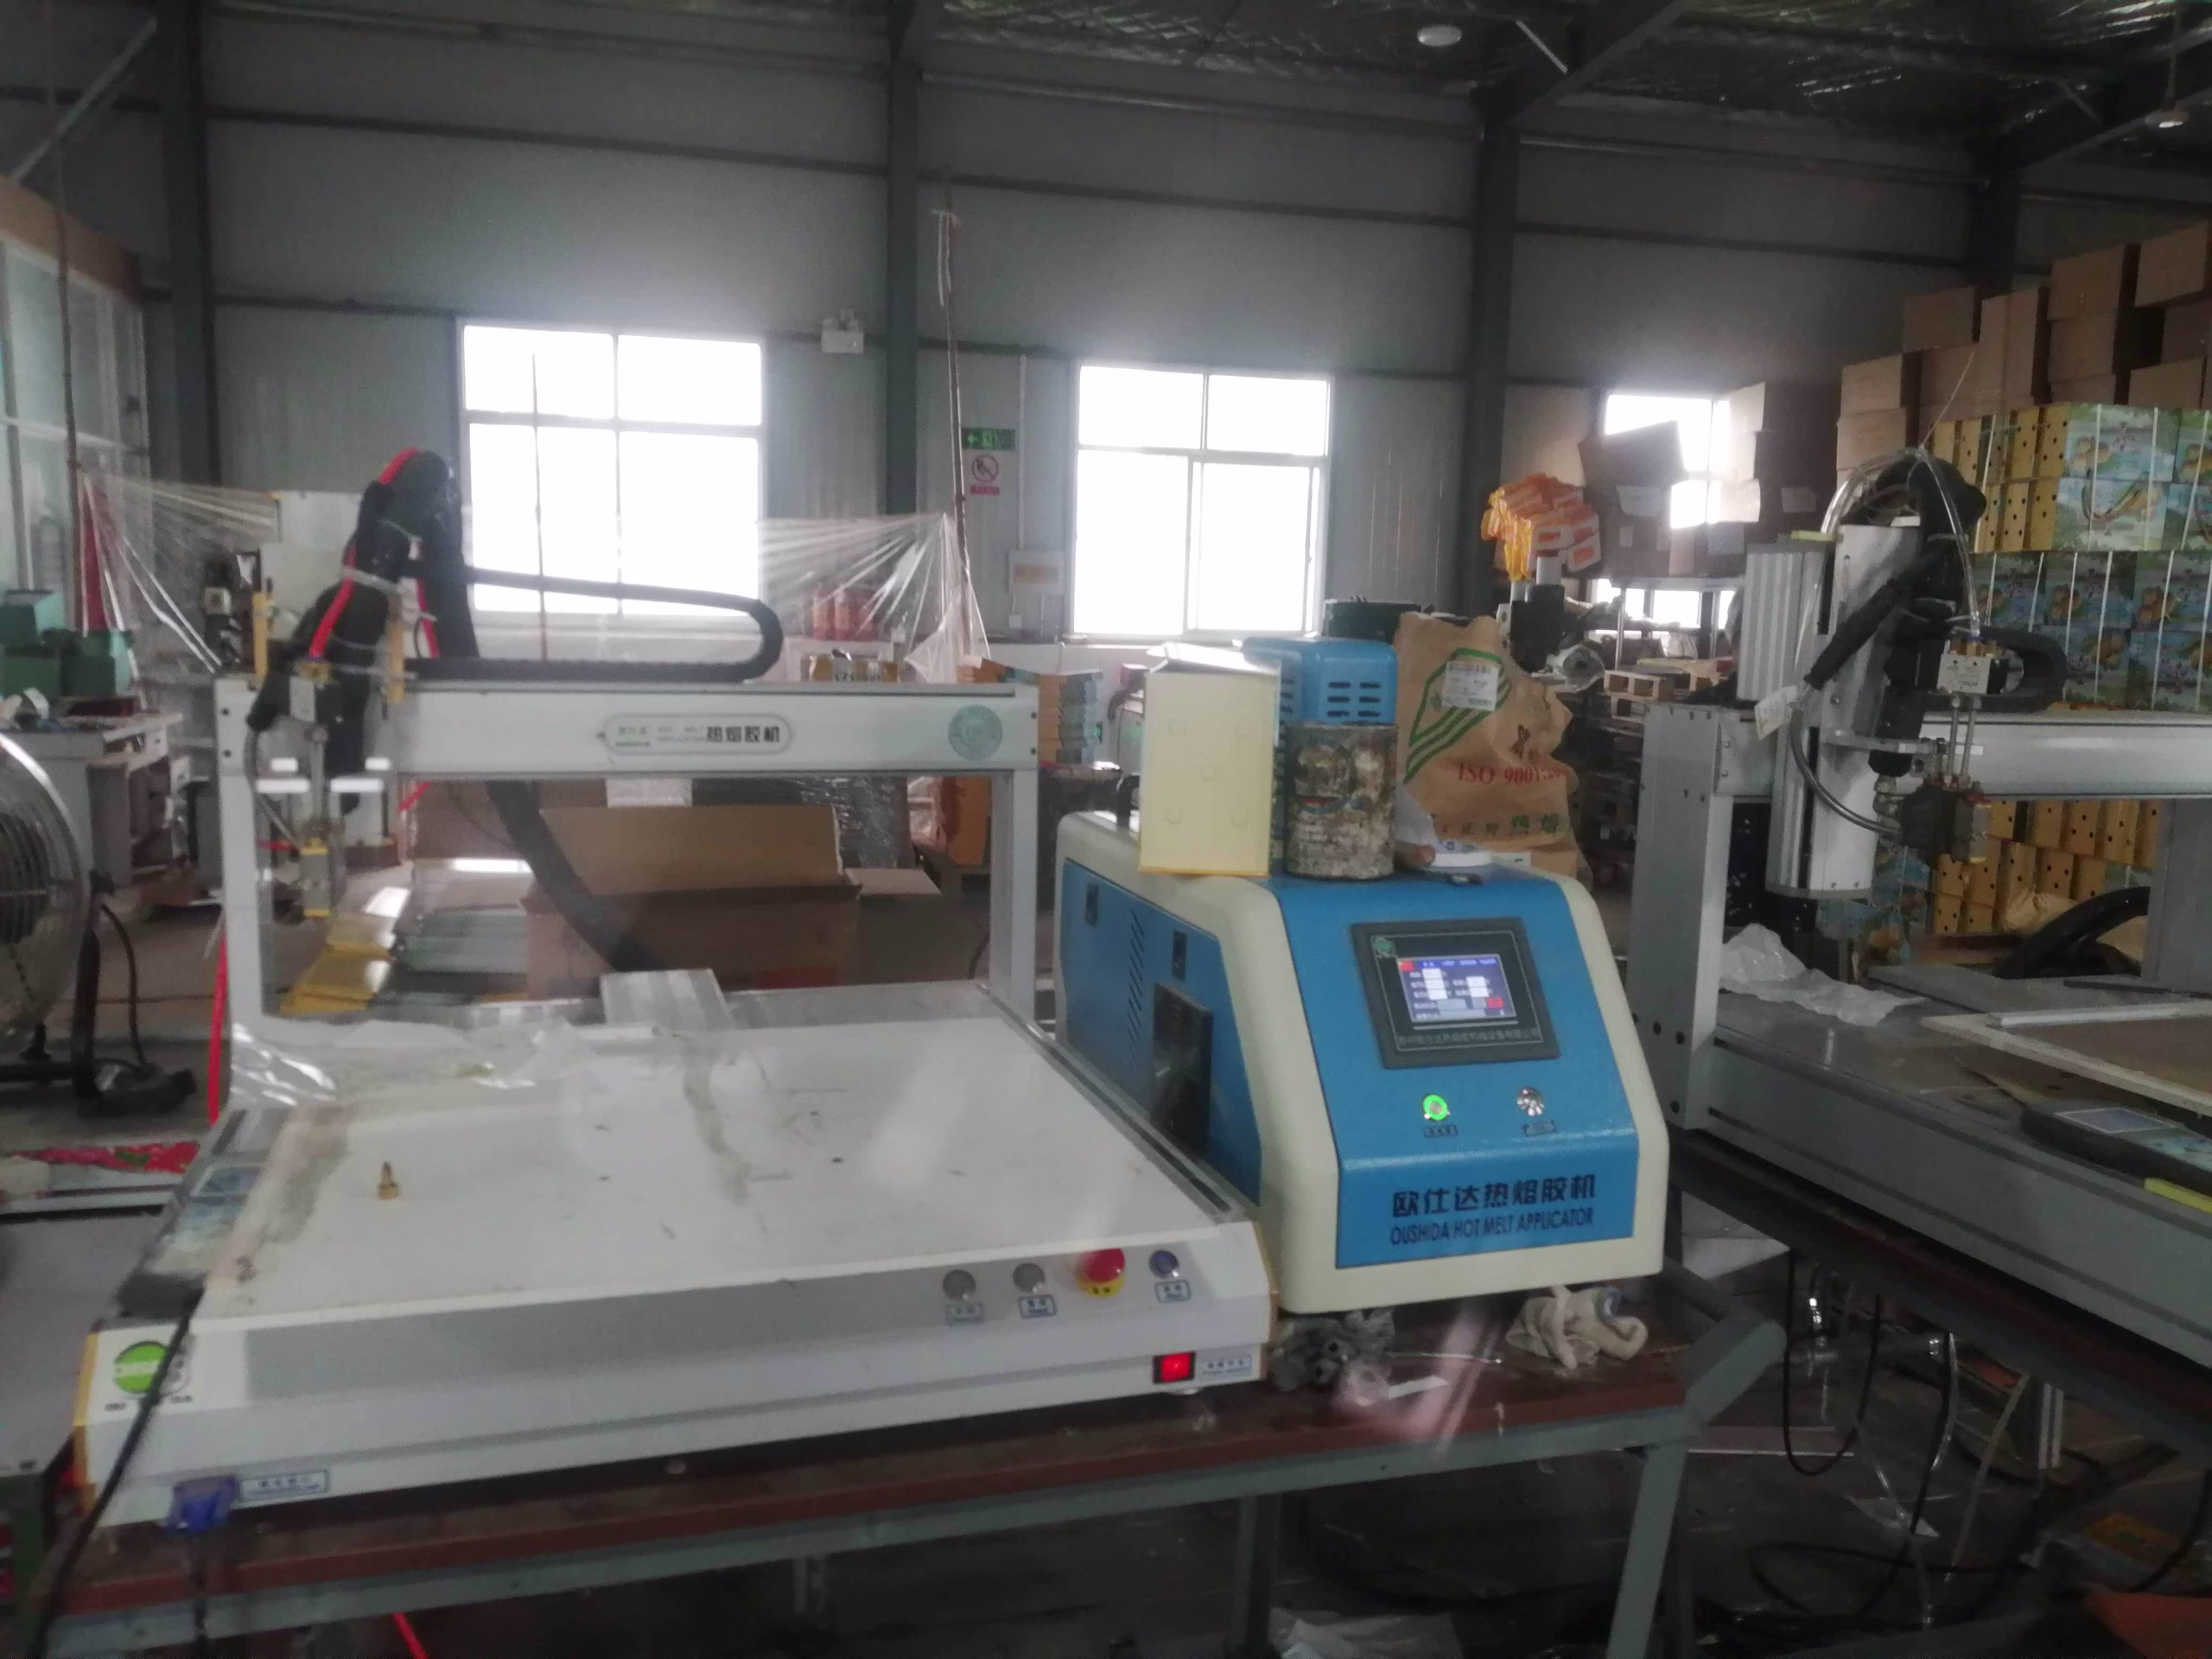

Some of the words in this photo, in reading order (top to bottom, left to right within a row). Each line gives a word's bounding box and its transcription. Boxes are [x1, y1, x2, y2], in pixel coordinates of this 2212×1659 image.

[1458, 763, 1495, 785] ISO
[1392, 1173, 1596, 1218] 欧仕达热熔胶机
[1390, 1222, 1450, 1246] OUSHIDA
[1453, 1217, 1480, 1238] HOT
[1484, 1214, 1514, 1236] MELT
[1517, 1207, 1594, 1232] APPLICATOR
